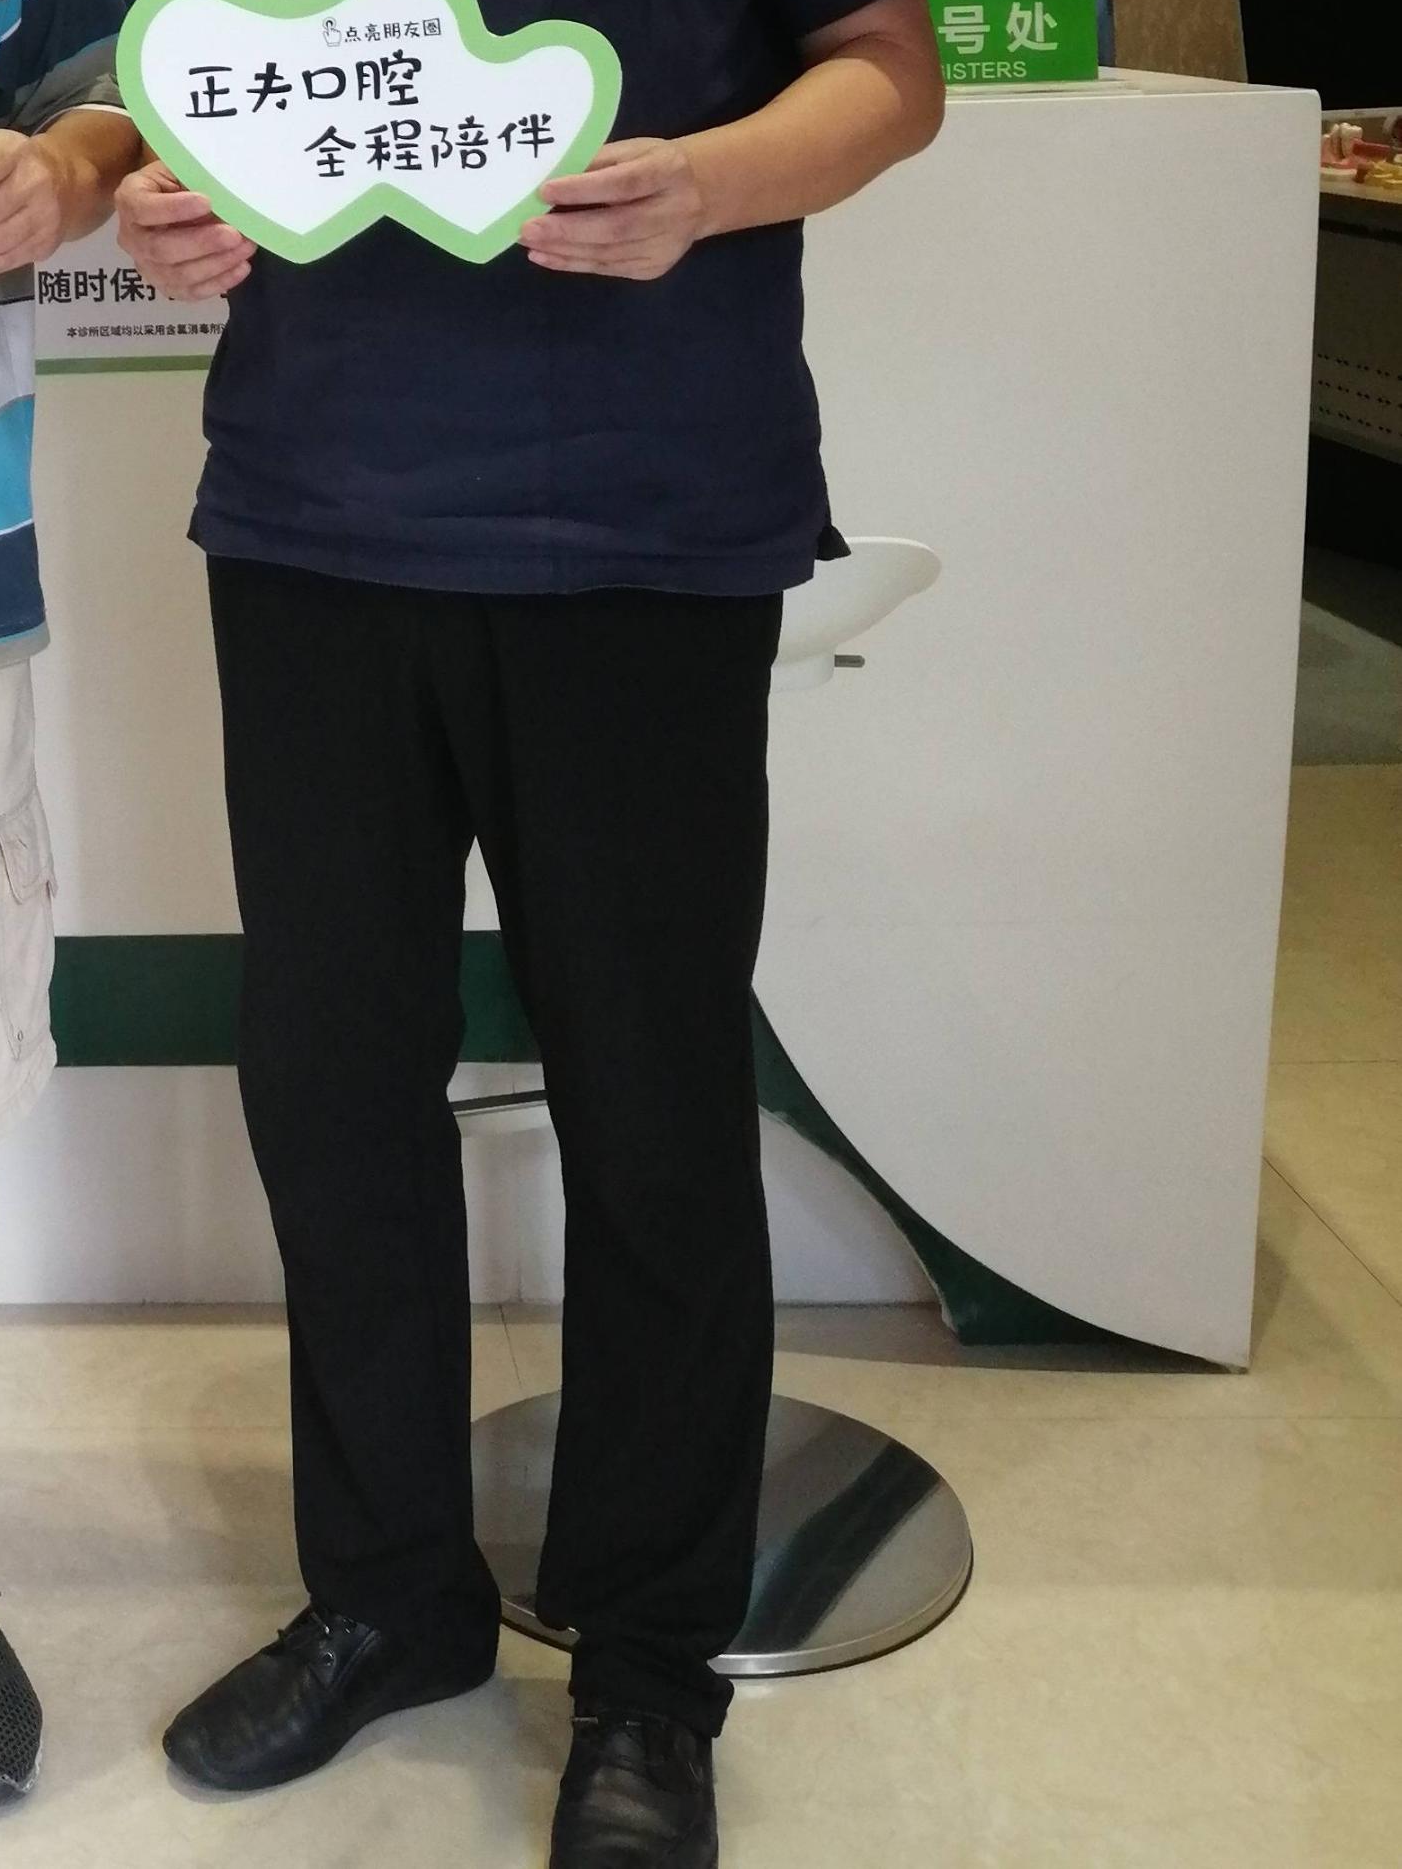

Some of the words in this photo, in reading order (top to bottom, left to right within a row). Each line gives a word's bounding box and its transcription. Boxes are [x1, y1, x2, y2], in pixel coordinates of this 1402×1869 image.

[344, 17, 442, 43] 点亮朋友圈
[938, 1, 1058, 55] 号处
[185, 48, 423, 119] 正夫口腔
[942, 61, 1027, 80] ISTERS
[303, 112, 556, 178] 全程陪伴
[38, 267, 156, 305] 随时保
